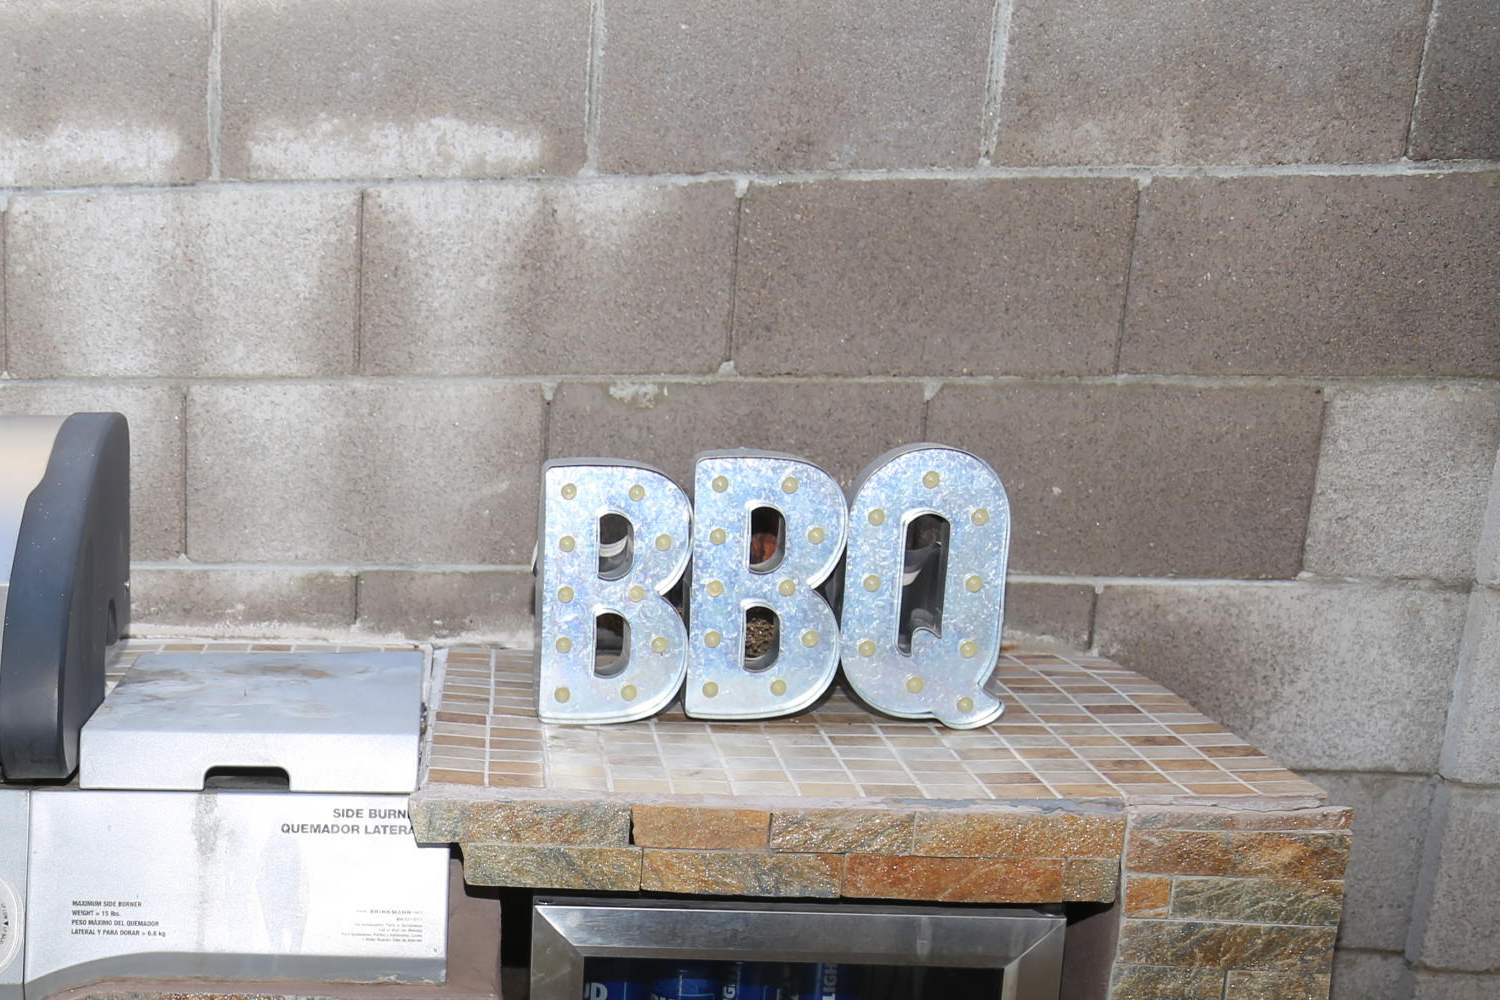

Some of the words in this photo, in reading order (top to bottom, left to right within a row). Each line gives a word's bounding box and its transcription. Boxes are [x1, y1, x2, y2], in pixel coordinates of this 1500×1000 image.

[537, 444, 1006, 730] BBQ
[333, 808, 363, 818] SIDE
[368, 809, 408, 819] BURN
[281, 823, 359, 834] QUEMADOR
[365, 825, 415, 835] LATERA
[126, 920, 159, 928] QUEMADOR
[120, 929, 140, 937] DORAR
